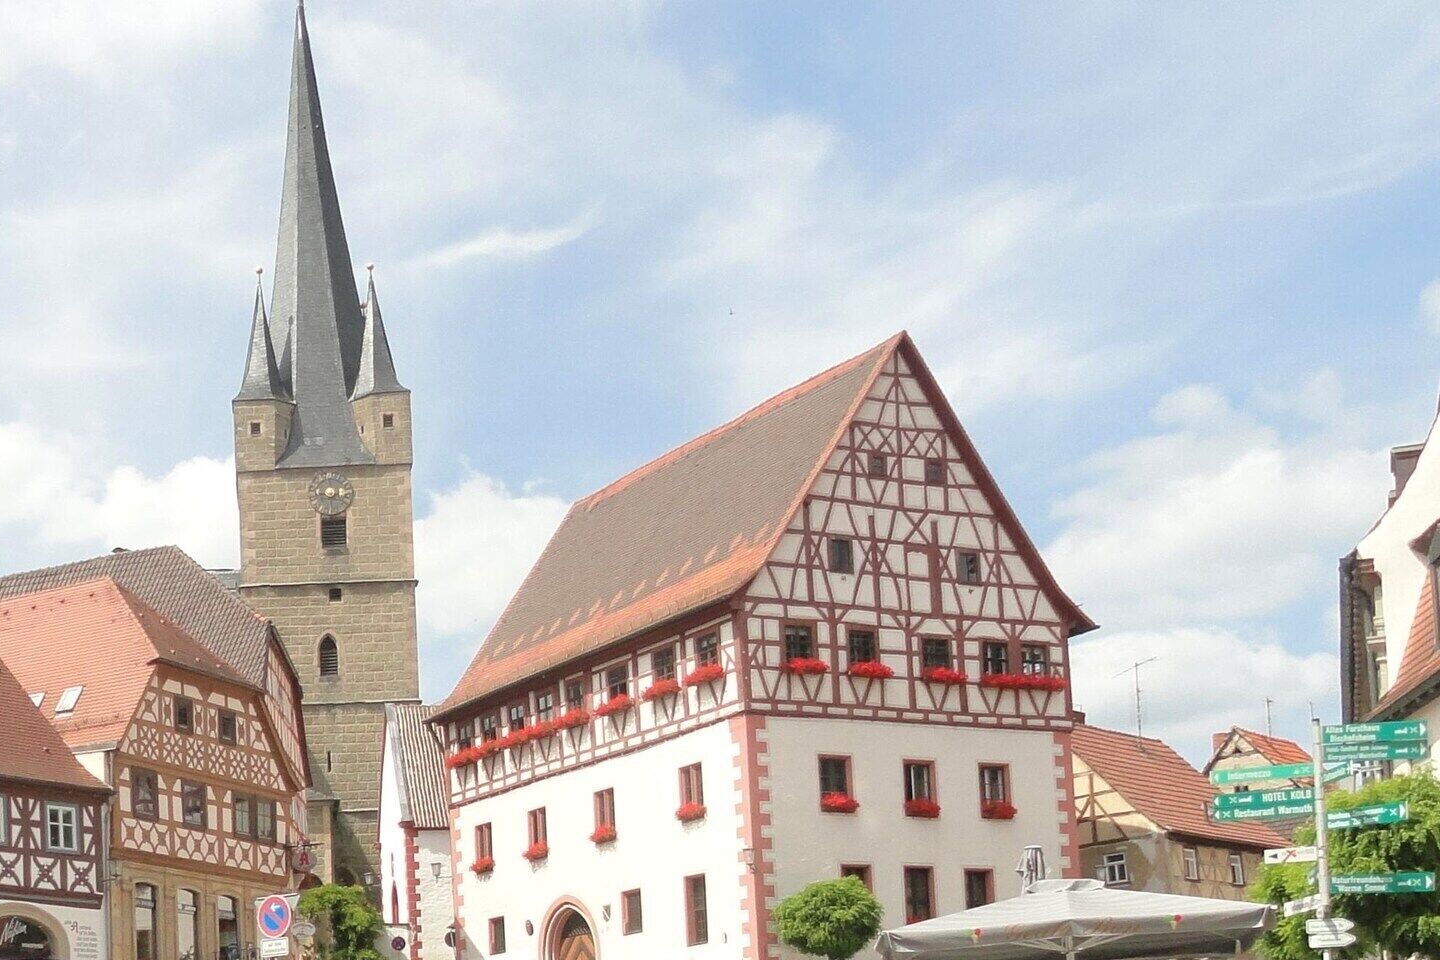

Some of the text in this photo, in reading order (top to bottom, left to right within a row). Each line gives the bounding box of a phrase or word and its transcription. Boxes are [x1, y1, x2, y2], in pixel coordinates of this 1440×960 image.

[1262, 789, 1312, 802] HOTEL KOLB
[1234, 803, 1313, 818] Restaurant Warmuth
